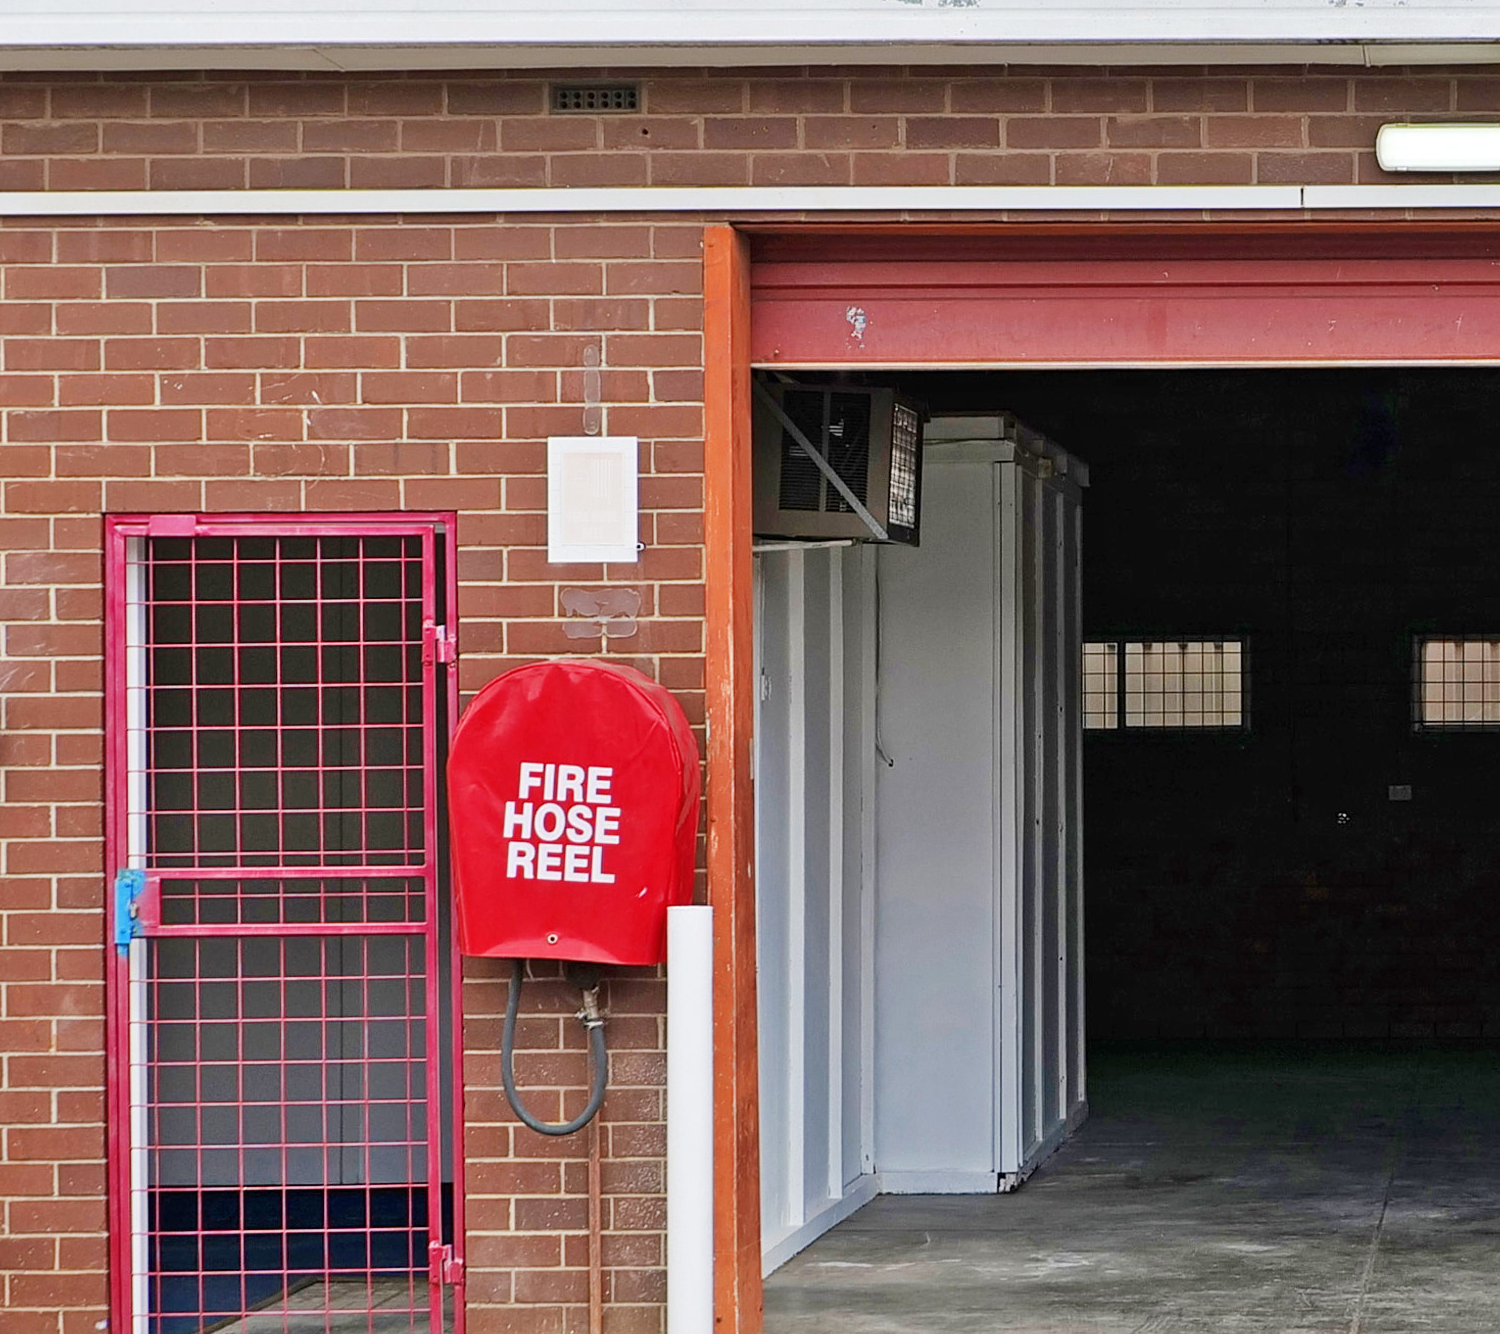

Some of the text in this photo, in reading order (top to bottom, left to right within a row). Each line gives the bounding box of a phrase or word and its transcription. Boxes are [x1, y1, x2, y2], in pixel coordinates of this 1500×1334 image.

[518, 762, 613, 804] FIRE
[503, 801, 621, 845] HOSE
[506, 841, 615, 884] REEL
